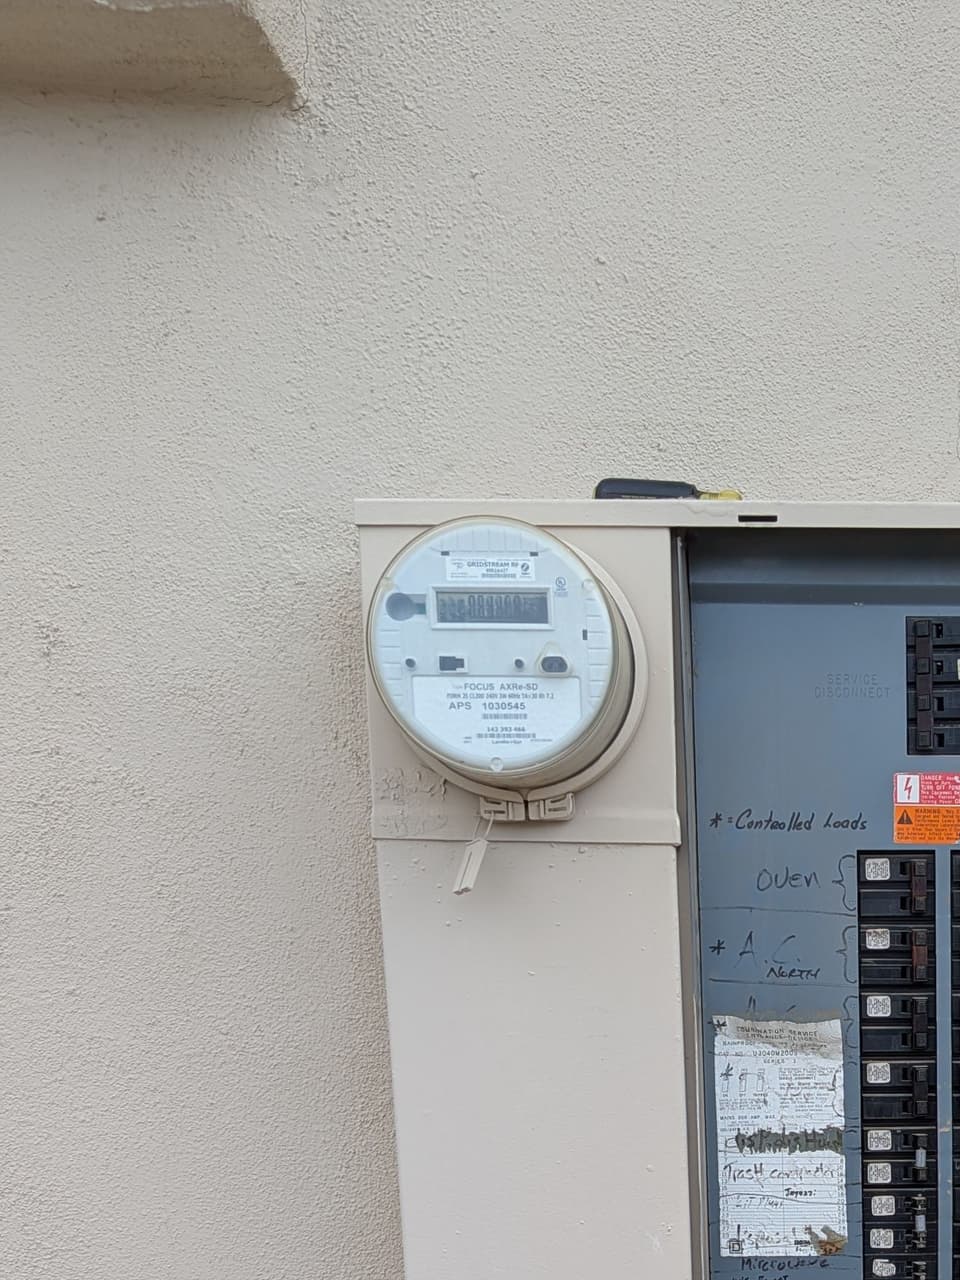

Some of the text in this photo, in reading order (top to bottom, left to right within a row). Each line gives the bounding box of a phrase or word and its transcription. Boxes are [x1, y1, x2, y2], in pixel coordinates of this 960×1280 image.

[826, 673, 879, 685] SERVICE
[463, 683, 495, 691] FOCUS
[814, 686, 891, 698] DISCONNECT
[448, 702, 526, 710] APS 1030545
[735, 808, 816, 832] Controlled
[766, 966, 821, 980] NORTH
[788, 1029, 817, 1037] SERVICE
